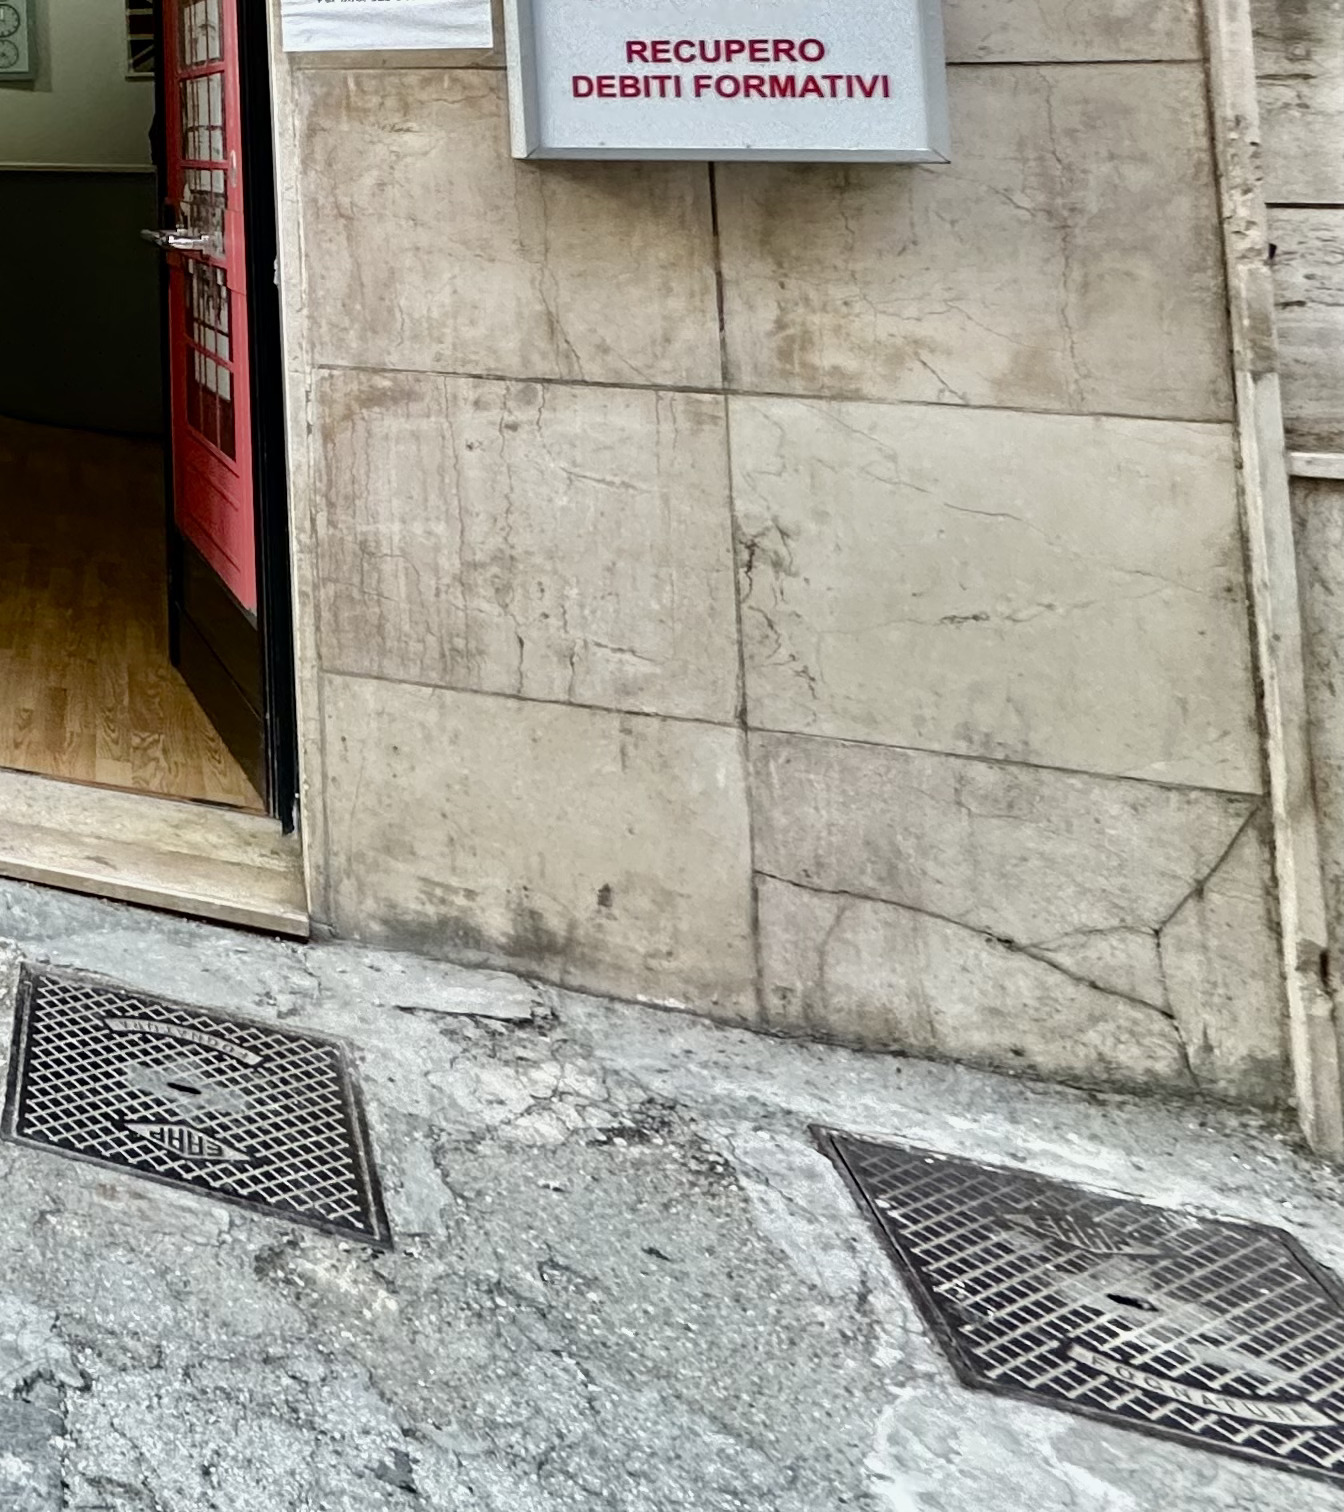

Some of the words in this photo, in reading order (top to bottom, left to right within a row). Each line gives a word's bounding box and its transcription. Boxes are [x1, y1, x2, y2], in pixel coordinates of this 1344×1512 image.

[626, 39, 825, 63] RECUPERO
[572, 75, 681, 98] DEBITI
[693, 74, 890, 98] FORMATIVI
[1090, 1354, 1313, 1423] FOGNATURA
